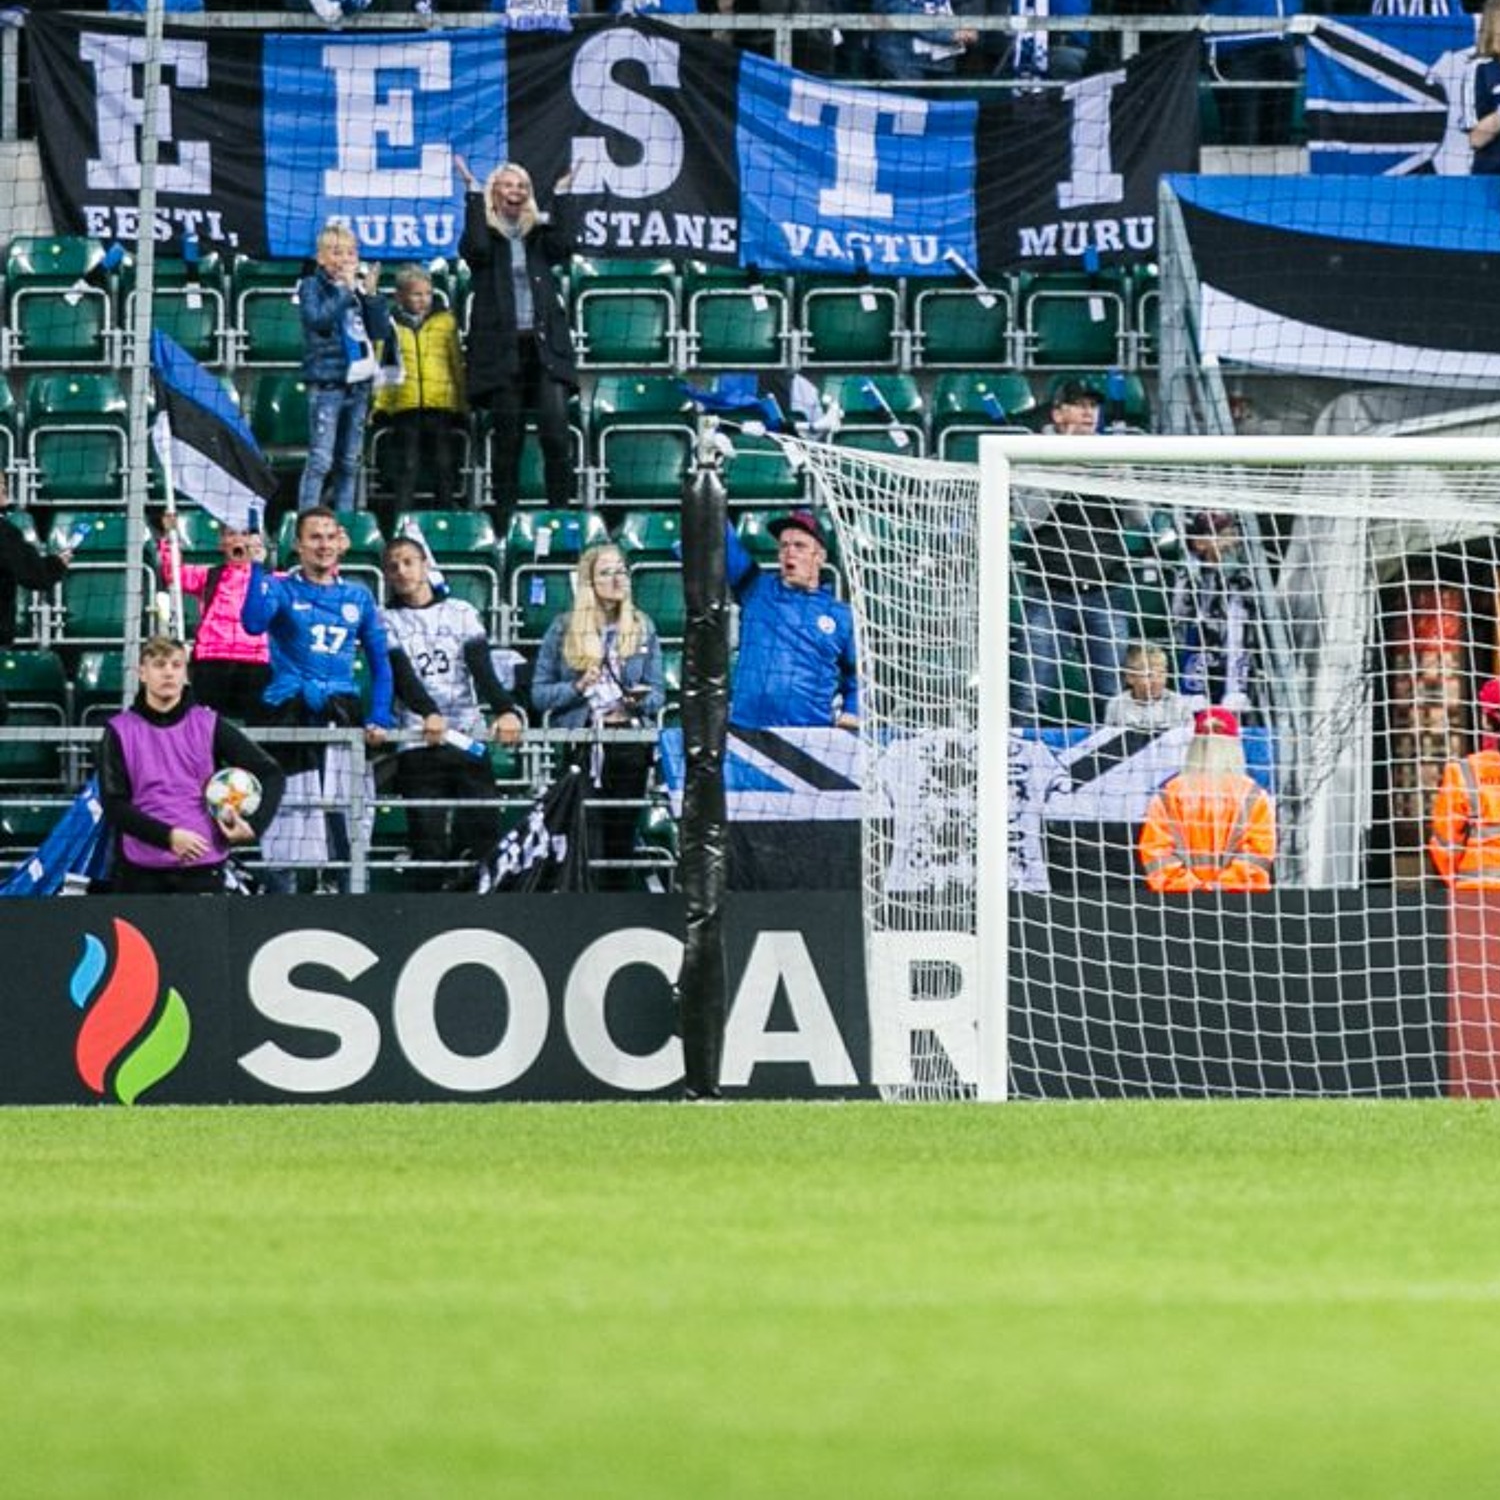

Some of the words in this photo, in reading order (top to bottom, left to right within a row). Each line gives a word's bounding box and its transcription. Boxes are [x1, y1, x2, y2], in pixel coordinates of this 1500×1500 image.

[83, 206, 239, 247] EESTI,
[780, 221, 939, 265] VASTU
[1018, 215, 1155, 256] MURU
[309, 624, 349, 654] 17
[416, 650, 450, 677] 23
[237, 927, 980, 1092] SOCAR
